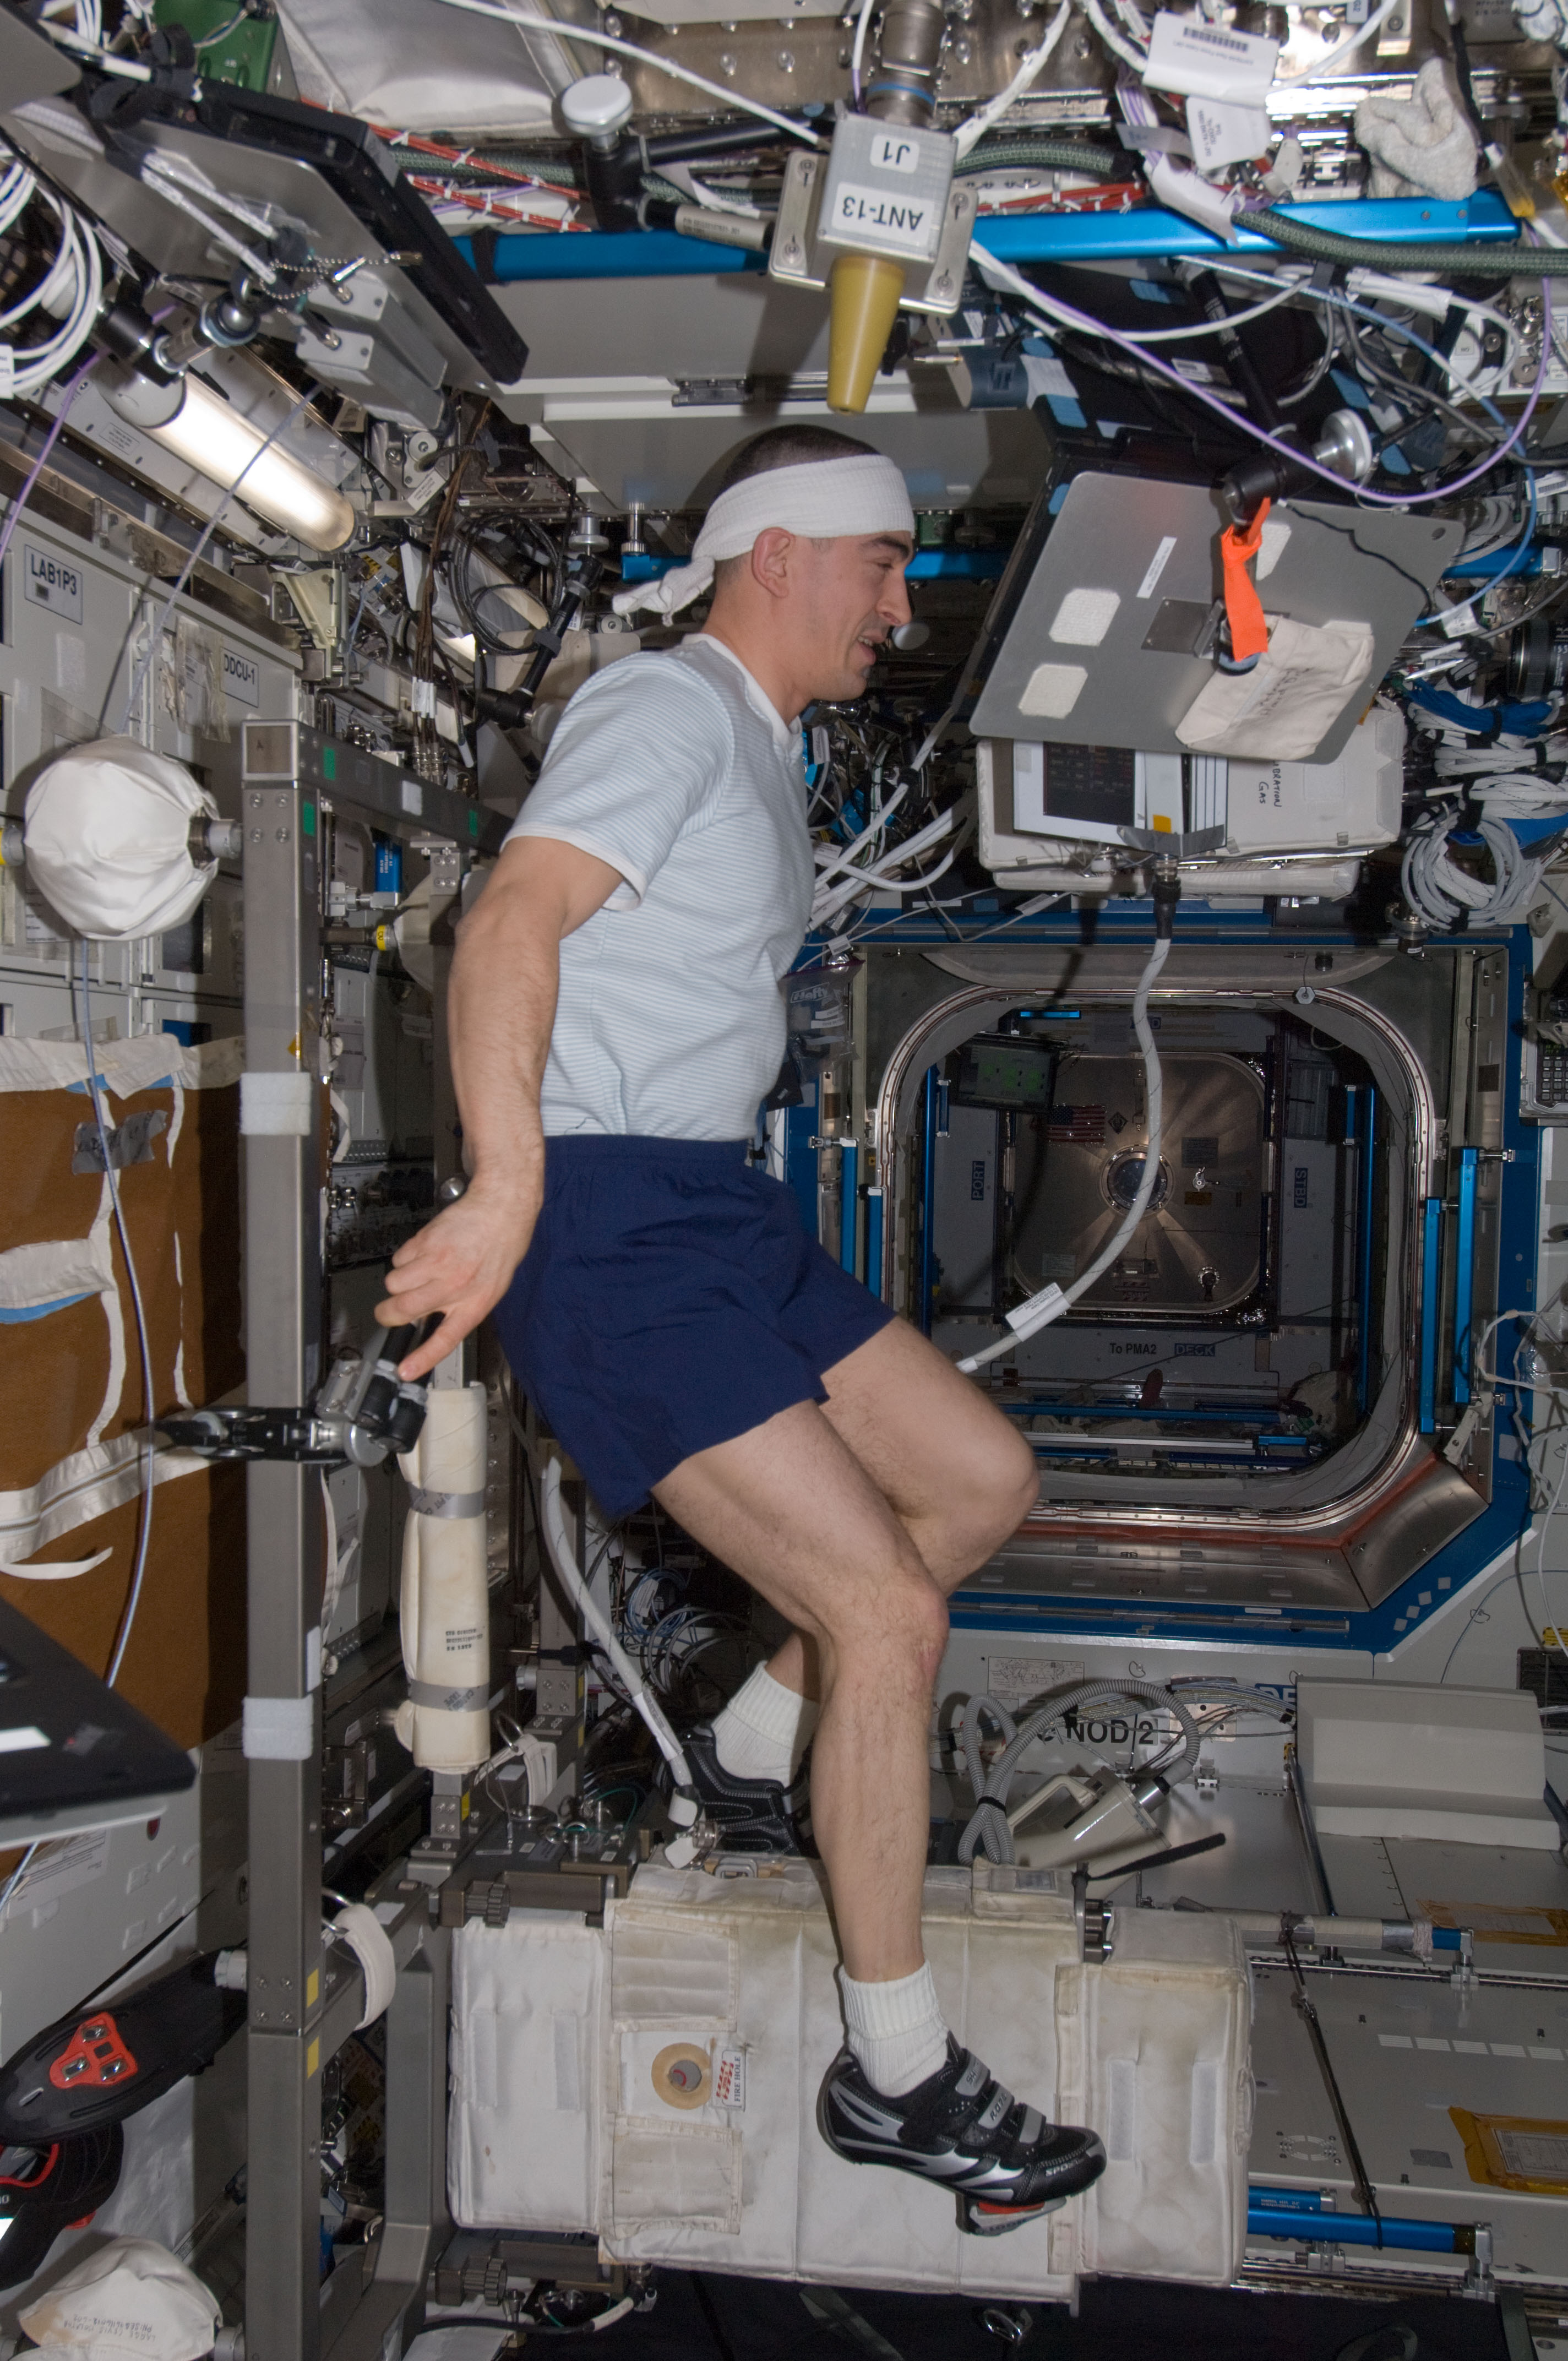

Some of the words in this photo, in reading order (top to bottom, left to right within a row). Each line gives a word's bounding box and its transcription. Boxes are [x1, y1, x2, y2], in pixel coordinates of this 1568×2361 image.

[883, 141, 911, 165] J1
[842, 195, 924, 230] ANT-13
[30, 552, 78, 596] LAB1P3
[793, 986, 828, 1001] Hefty
[973, 1163, 984, 1199] PORT
[1295, 1170, 1306, 1206] STBD
[1109, 1342, 1123, 1354] To
[1126, 1343, 1157, 1355] PMA2
[1175, 1343, 1215, 1356] DECK
